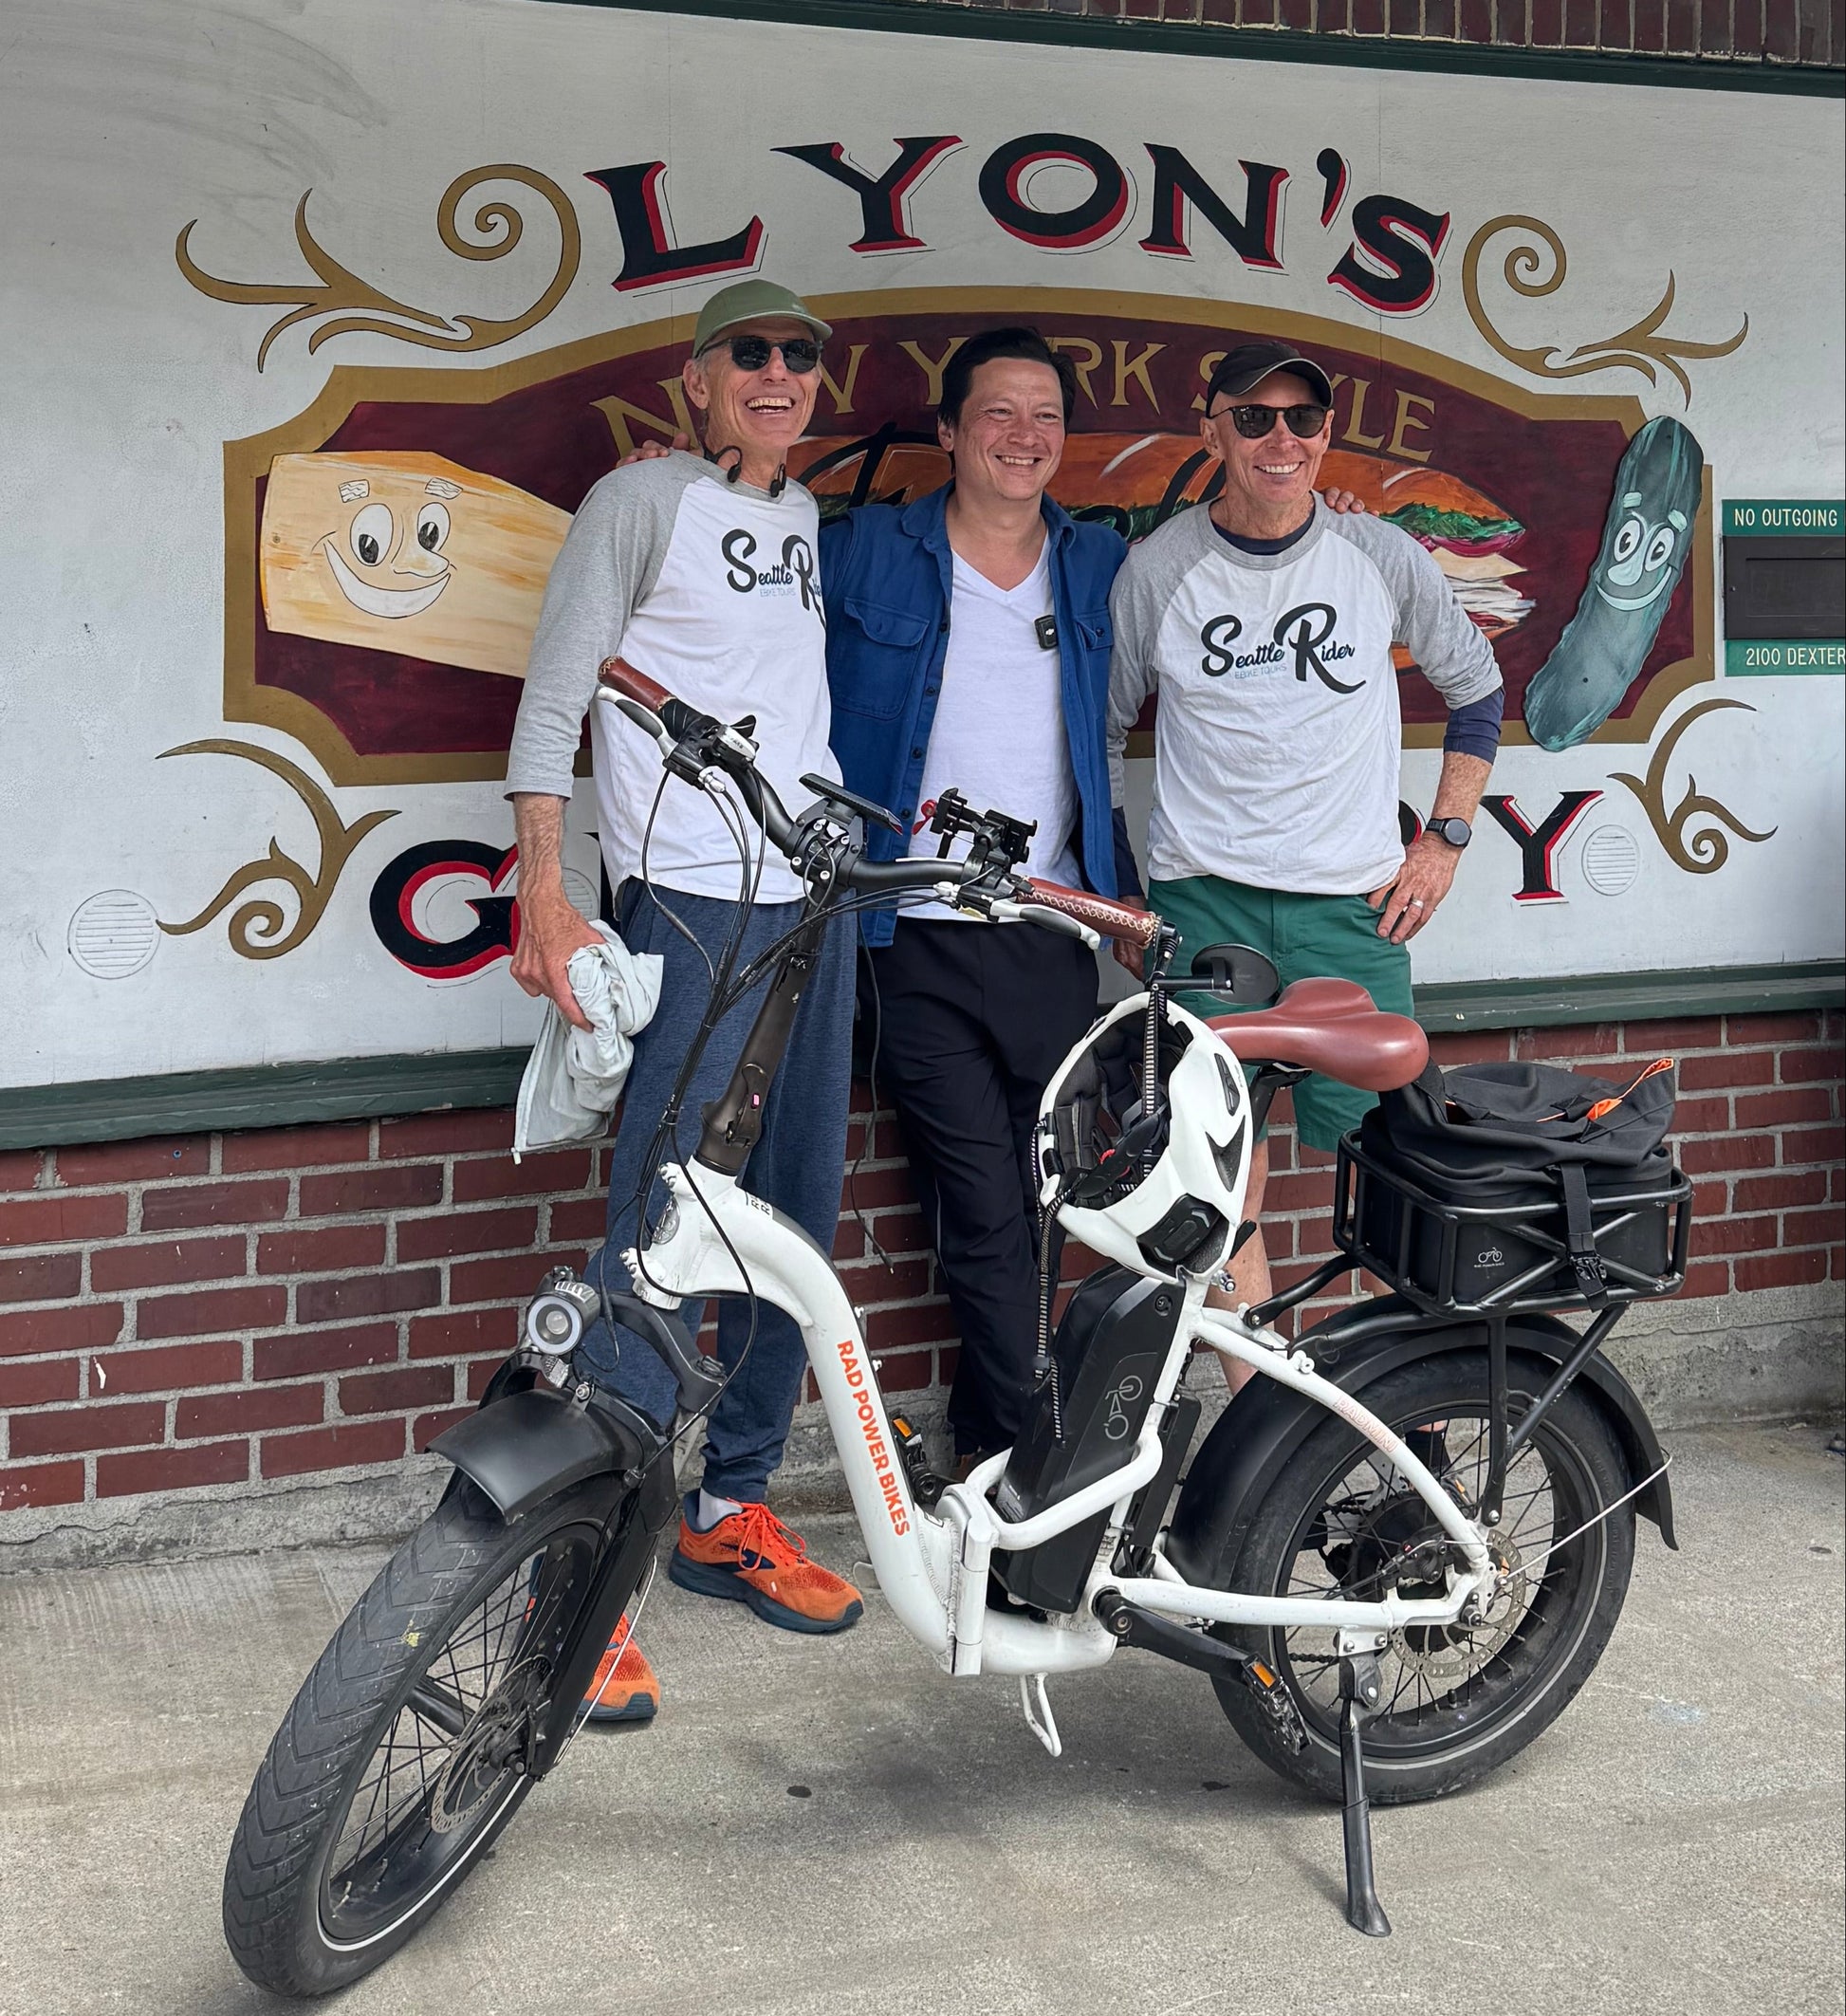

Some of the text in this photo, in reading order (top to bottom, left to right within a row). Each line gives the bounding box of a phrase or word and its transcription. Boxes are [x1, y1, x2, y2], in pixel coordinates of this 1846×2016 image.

[584, 132, 1451, 314] LYON'S
[899, 336, 1168, 416] YRK
[1734, 509, 1837, 527] NO OUTGOING
[722, 528, 793, 592] Seattle
[1201, 602, 1367, 694] Seattle Rider
[1745, 647, 1846, 666] 2100 DEXTER
[837, 1340, 911, 1537] RAD POWER BIKES
[1333, 1396, 1398, 1453] RADMINI
